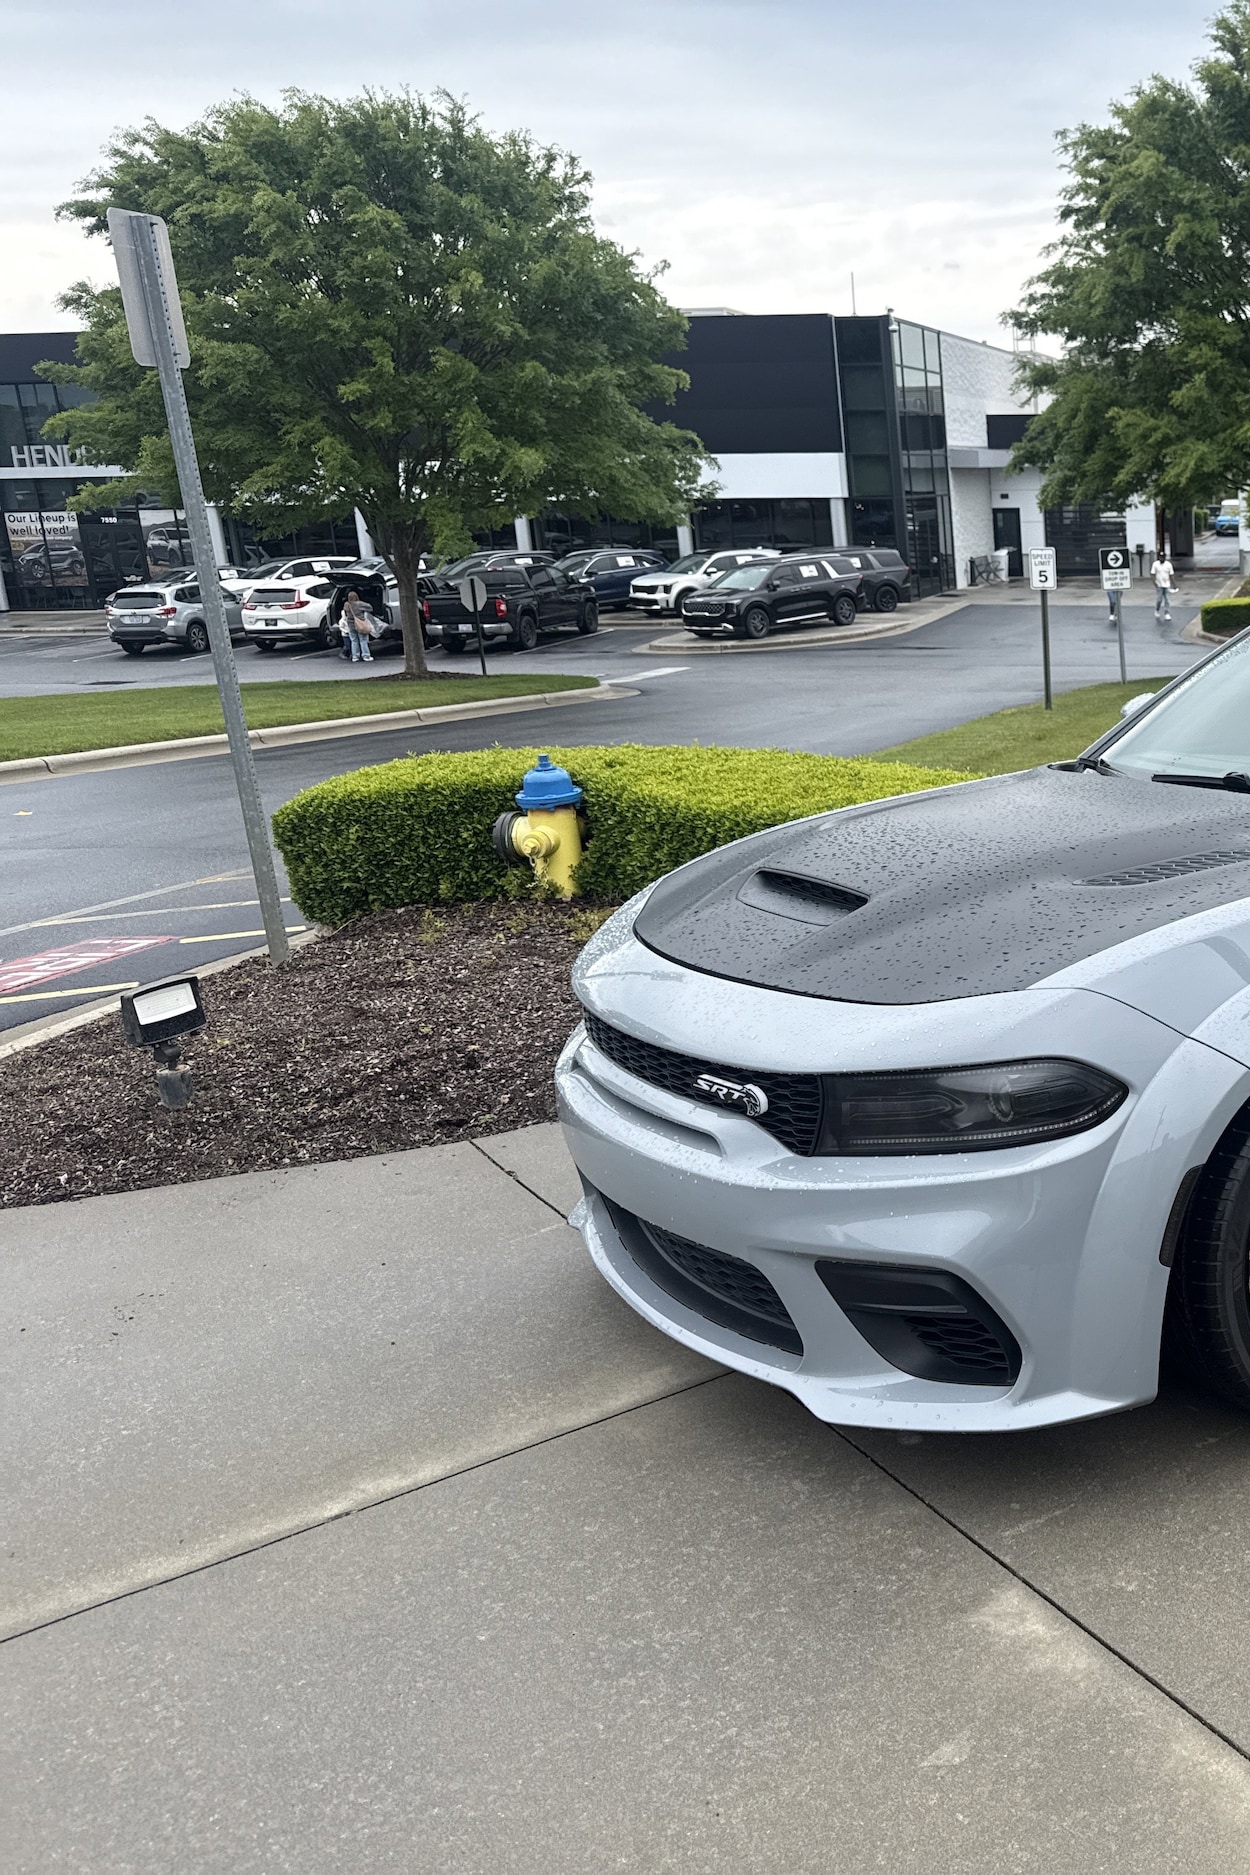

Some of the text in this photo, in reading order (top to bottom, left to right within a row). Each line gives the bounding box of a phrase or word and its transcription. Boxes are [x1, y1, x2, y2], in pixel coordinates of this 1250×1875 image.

[7, 512, 76, 524] Our Lineup is
[9, 525, 69, 535] well loved!
[1039, 570, 1048, 583] 5
[692, 1077, 747, 1100] SRT
